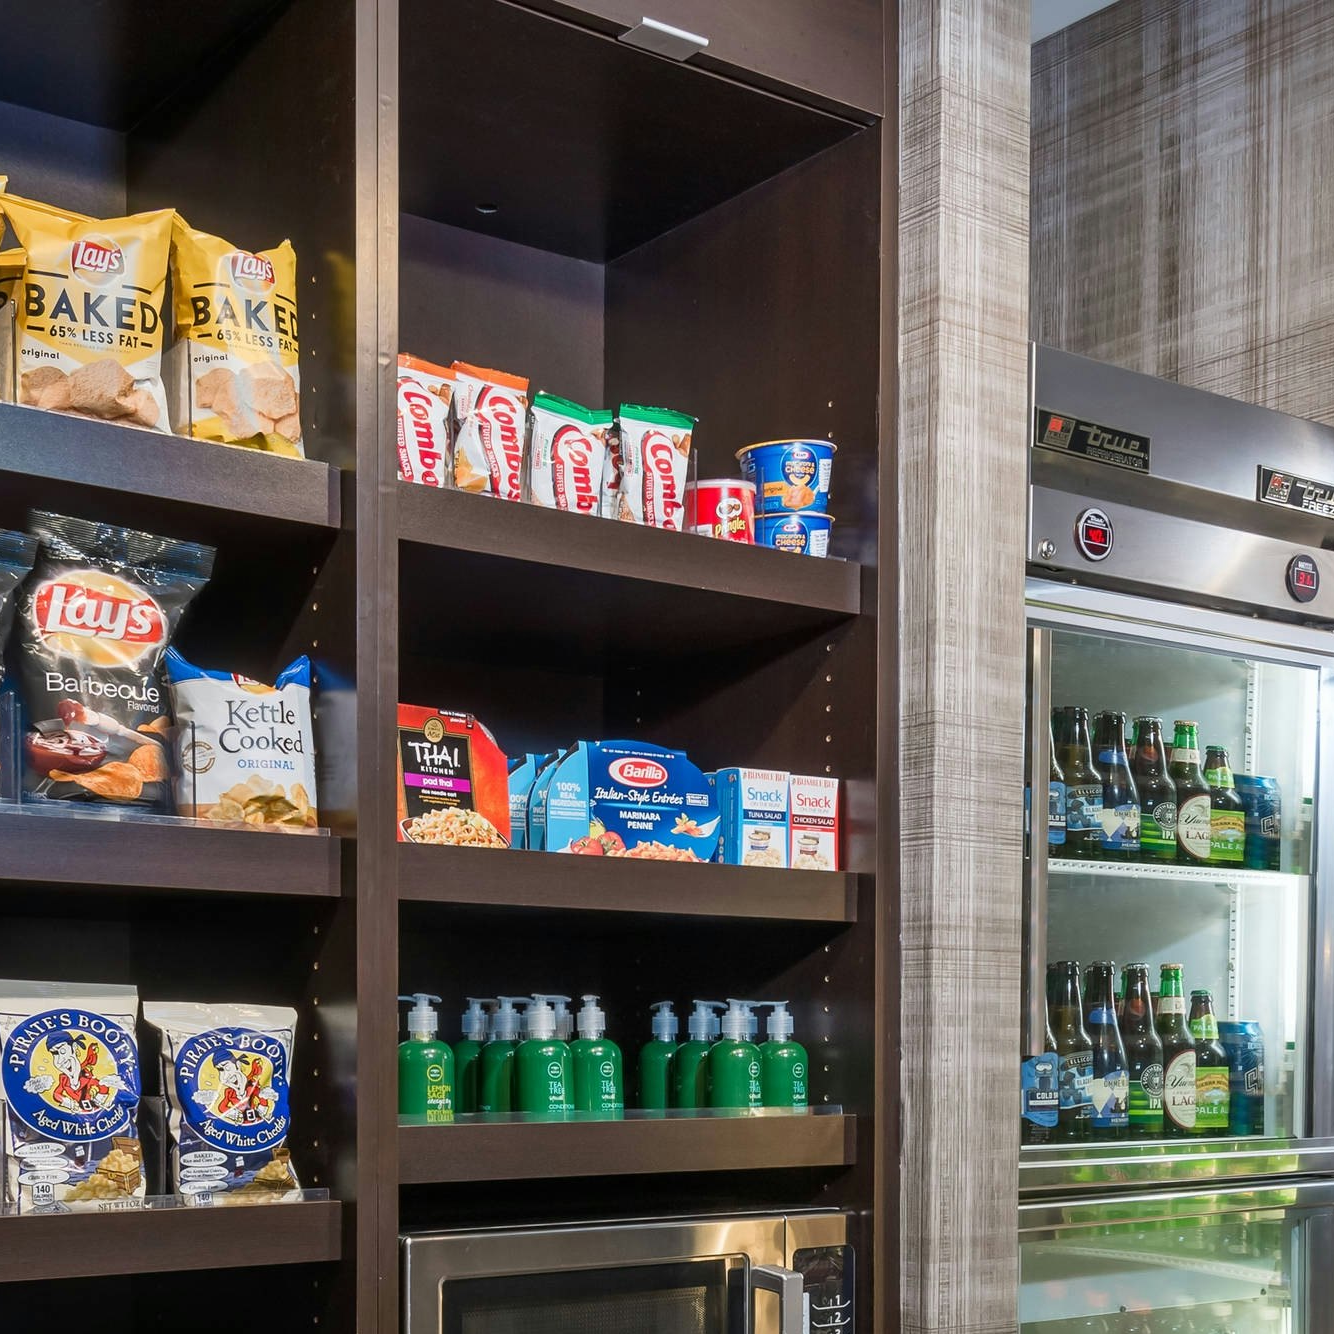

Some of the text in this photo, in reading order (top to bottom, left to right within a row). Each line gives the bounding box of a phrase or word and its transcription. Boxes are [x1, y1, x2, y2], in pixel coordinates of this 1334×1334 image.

[73, 240, 122, 273] Lay's
[25, 283, 159, 334] BAKED
[192, 295, 299, 342] BAKED
[49, 324, 139, 349] 65% LESS FAT
[216, 329, 293, 352] 65% LESS FAT
[21, 347, 60, 360] original
[193, 352, 229, 364] original
[45, 585, 155, 641] Lay's
[45, 672, 160, 703] Barbecue
[127, 700, 160, 715] Flavored
[225, 700, 296, 729] Kettle
[218, 728, 305, 755] Cooked
[237, 758, 295, 771] ORIGINAL
[421, 765, 454, 775] KITCHEN
[623, 765, 663, 780] Barilla
[422, 777, 453, 788] pad thai
[556, 782, 580, 792] 100%
[747, 788, 783, 802] Snack
[796, 794, 831, 809] Snack
[619, 811, 661, 821] MARINARA
[748, 811, 782, 820] TUNA SALAD
[793, 817, 834, 826] CHICKEN SALAD
[627, 821, 653, 830] PENNE
[1162, 831, 1175, 840] IPA
[10, 1013, 136, 1069] PIRATE'S BOOTY
[180, 1033, 283, 1081] PIRATE'S BOOTY
[199, 1116, 287, 1146] Aged White Cheddar
[36, 1185, 50, 1195] 140
